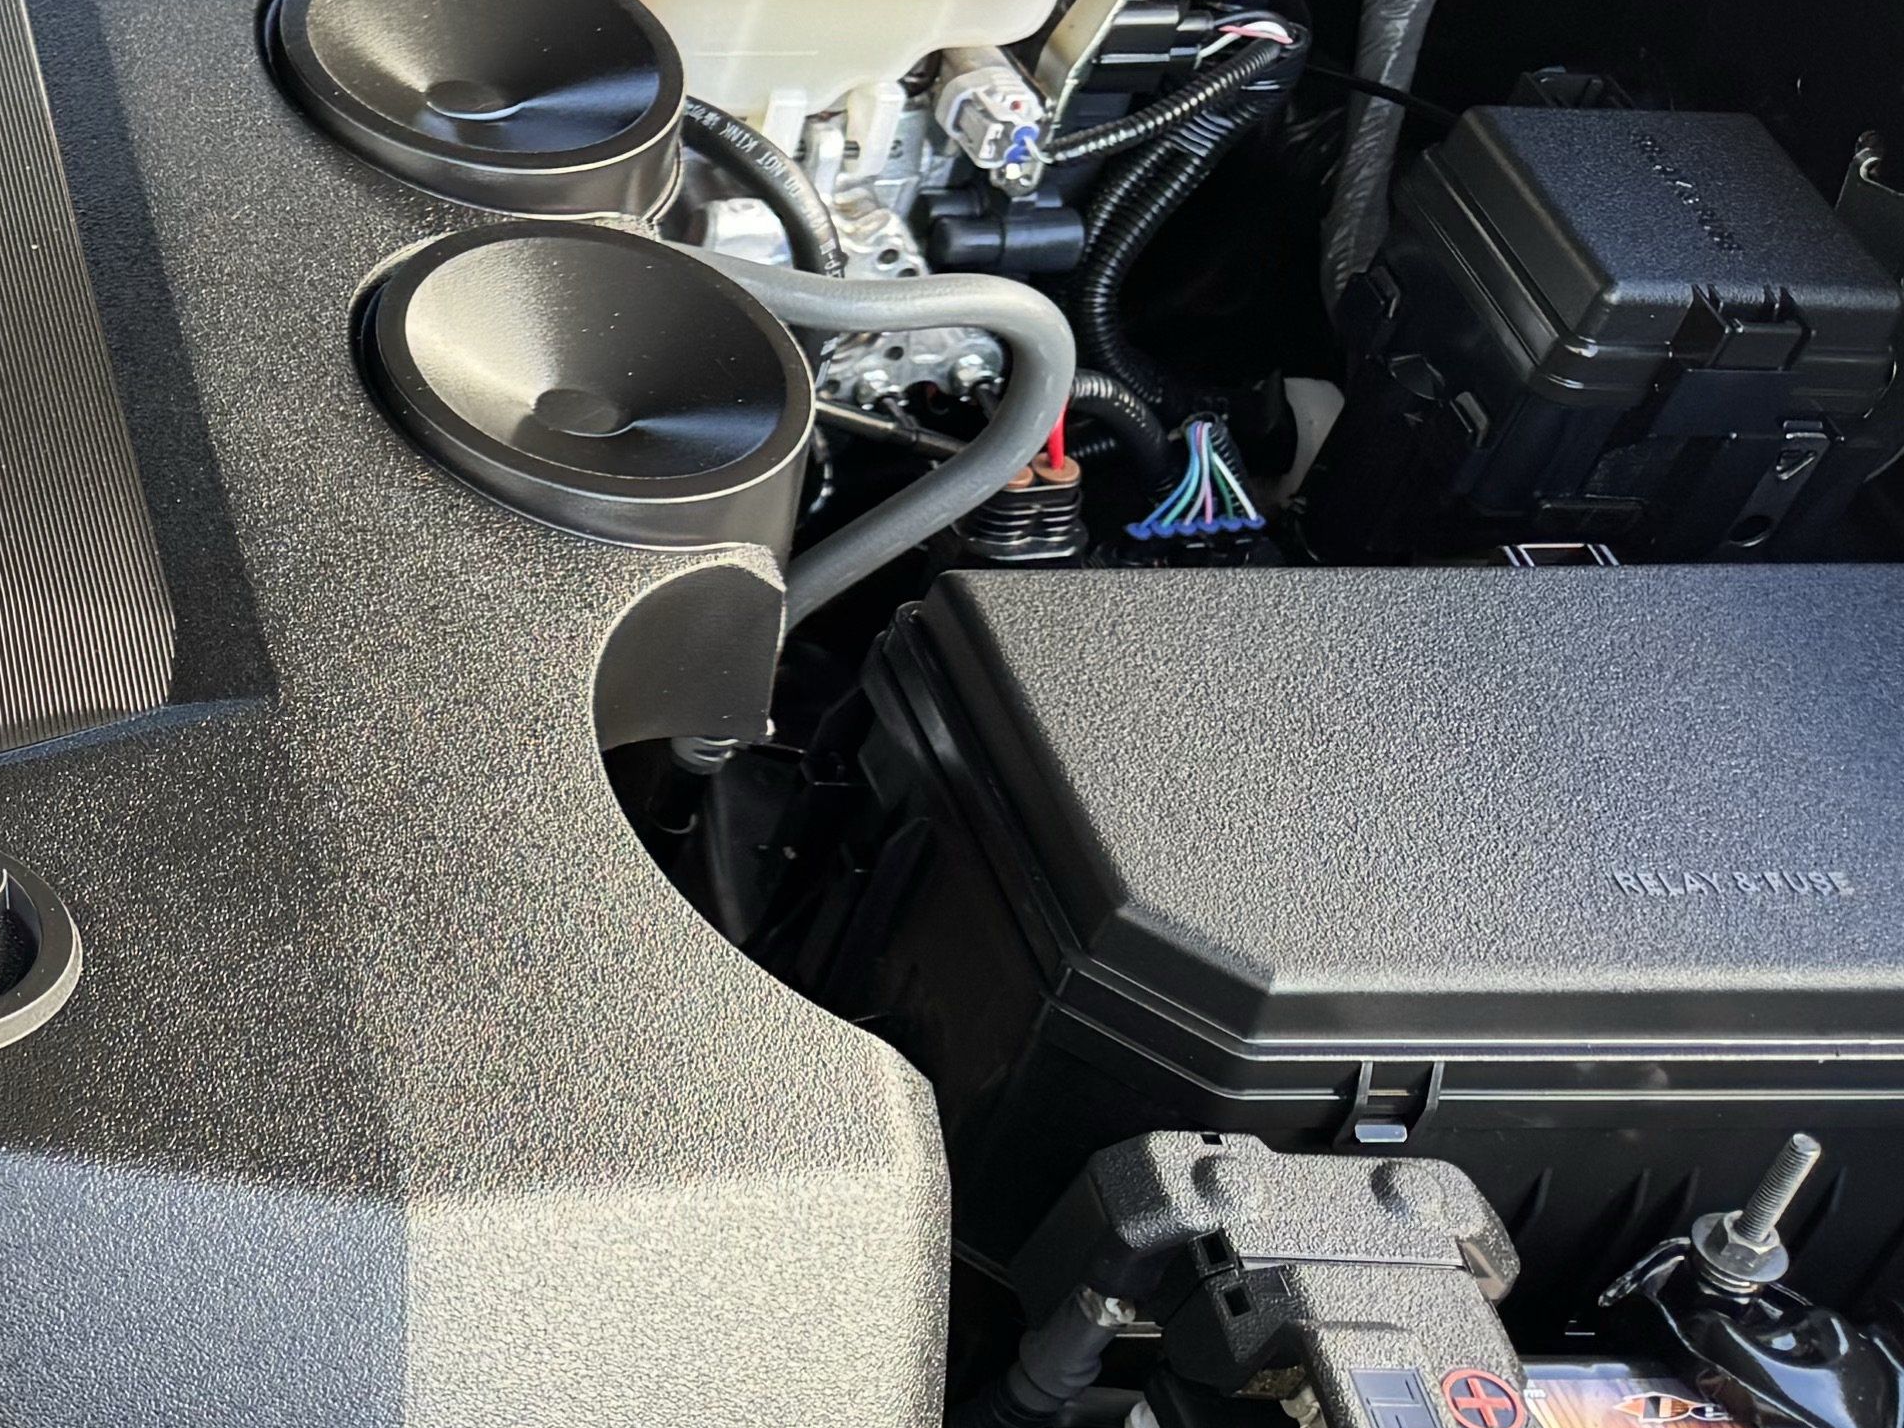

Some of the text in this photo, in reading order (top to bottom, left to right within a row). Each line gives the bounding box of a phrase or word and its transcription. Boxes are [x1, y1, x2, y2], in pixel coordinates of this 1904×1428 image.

[719, 123, 759, 154] KINK
[756, 151, 788, 176] NOT
[1613, 869, 1856, 898] RELAY & FUSE
